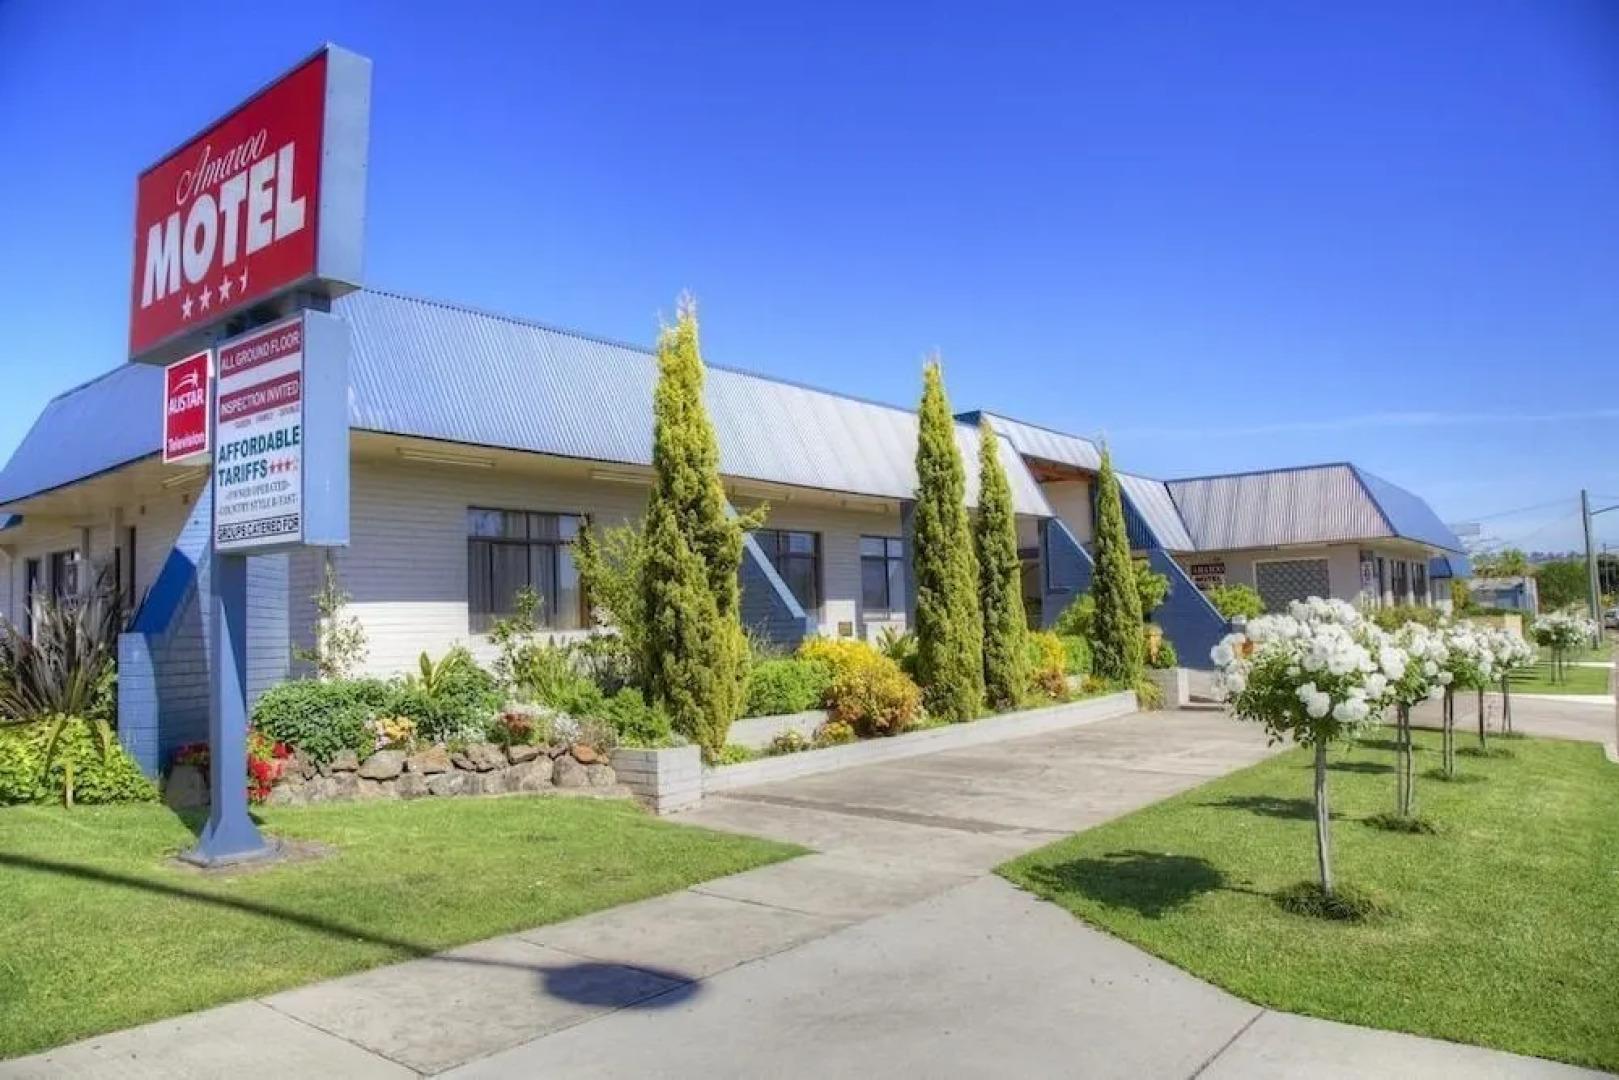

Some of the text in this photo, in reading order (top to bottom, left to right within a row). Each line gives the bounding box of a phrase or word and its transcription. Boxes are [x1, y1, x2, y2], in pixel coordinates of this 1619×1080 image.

[176, 129, 267, 206] Amaroo
[141, 141, 306, 309] MOTEL
[221, 330, 300, 370] ALL GROUND FLOOR
[168, 388, 203, 414] AUSTAR
[221, 380, 299, 415] INSPECTION INVITED
[218, 425, 300, 463] AFFORDABLE
[218, 459, 267, 487] TARIFFS
[250, 497, 270, 512] STYLE
[218, 516, 299, 540] GROUPS CATERED FOR
